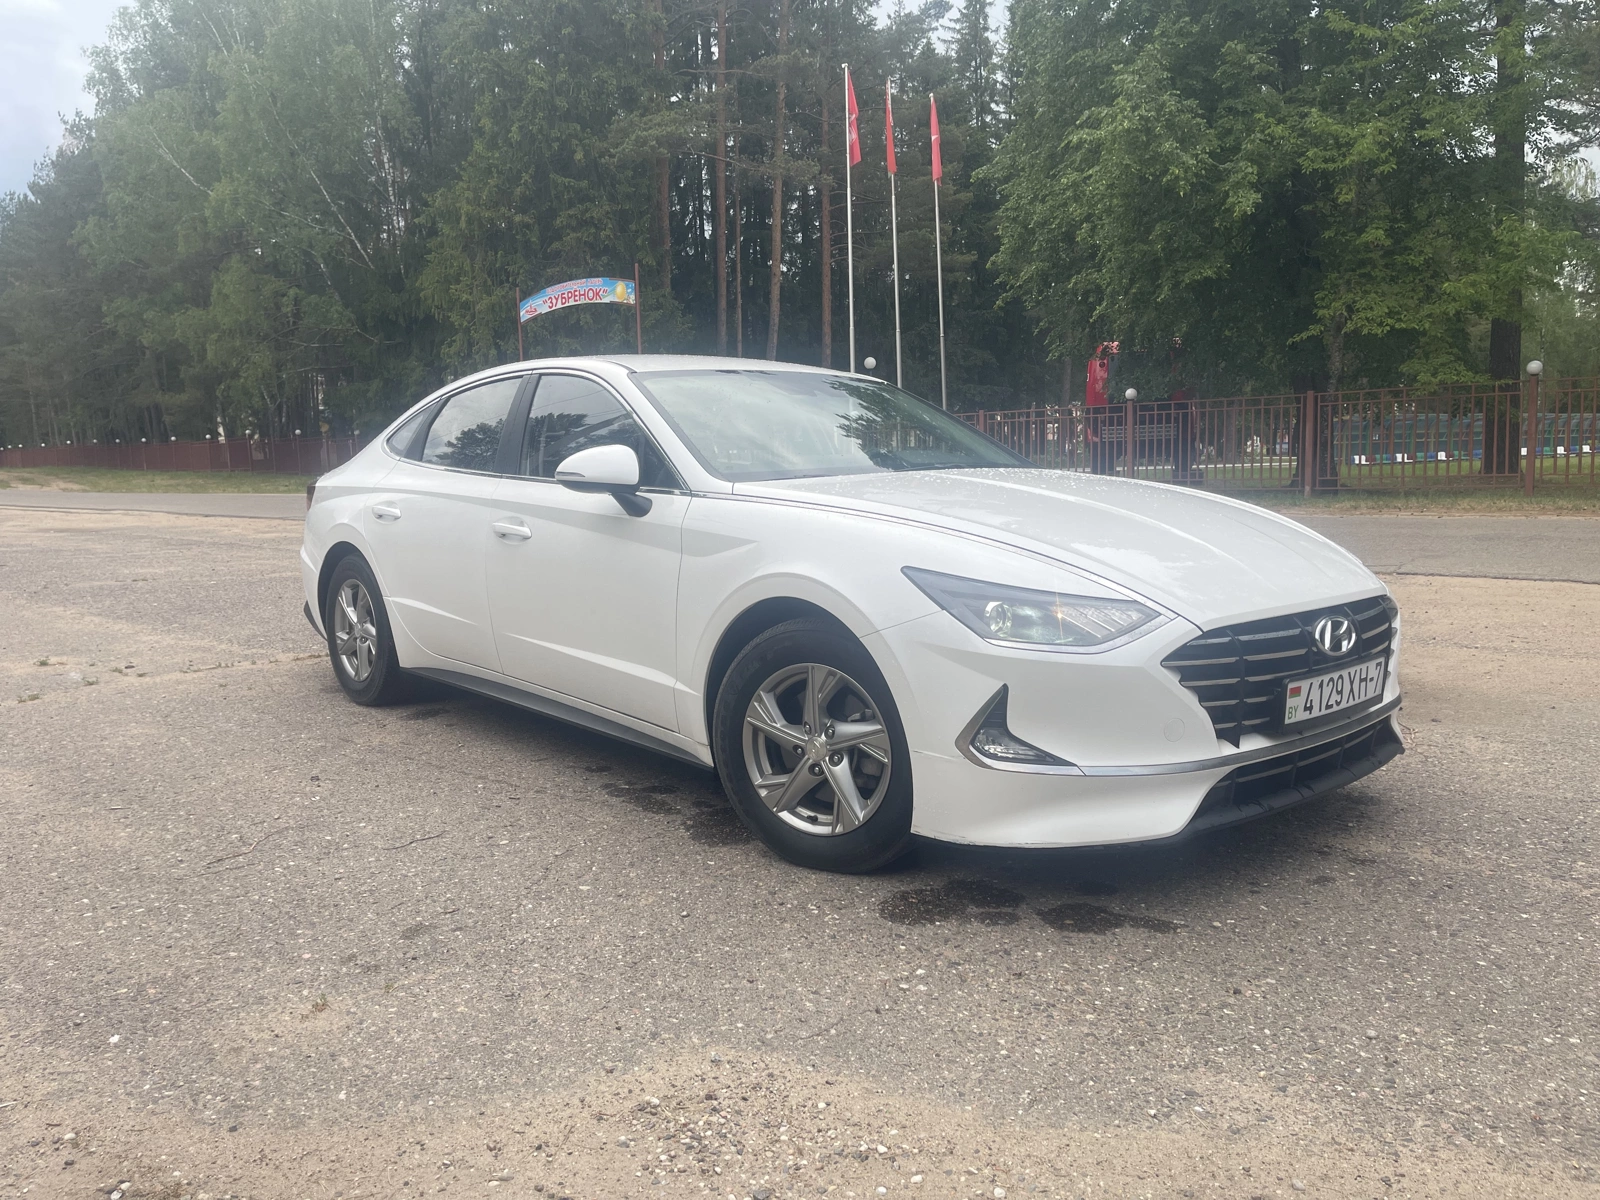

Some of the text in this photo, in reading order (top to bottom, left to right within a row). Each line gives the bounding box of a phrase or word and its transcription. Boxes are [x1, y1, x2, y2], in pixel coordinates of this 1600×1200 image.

[1303, 661, 1383, 715] 4129 XH-7
[1288, 705, 1299, 720] BY
